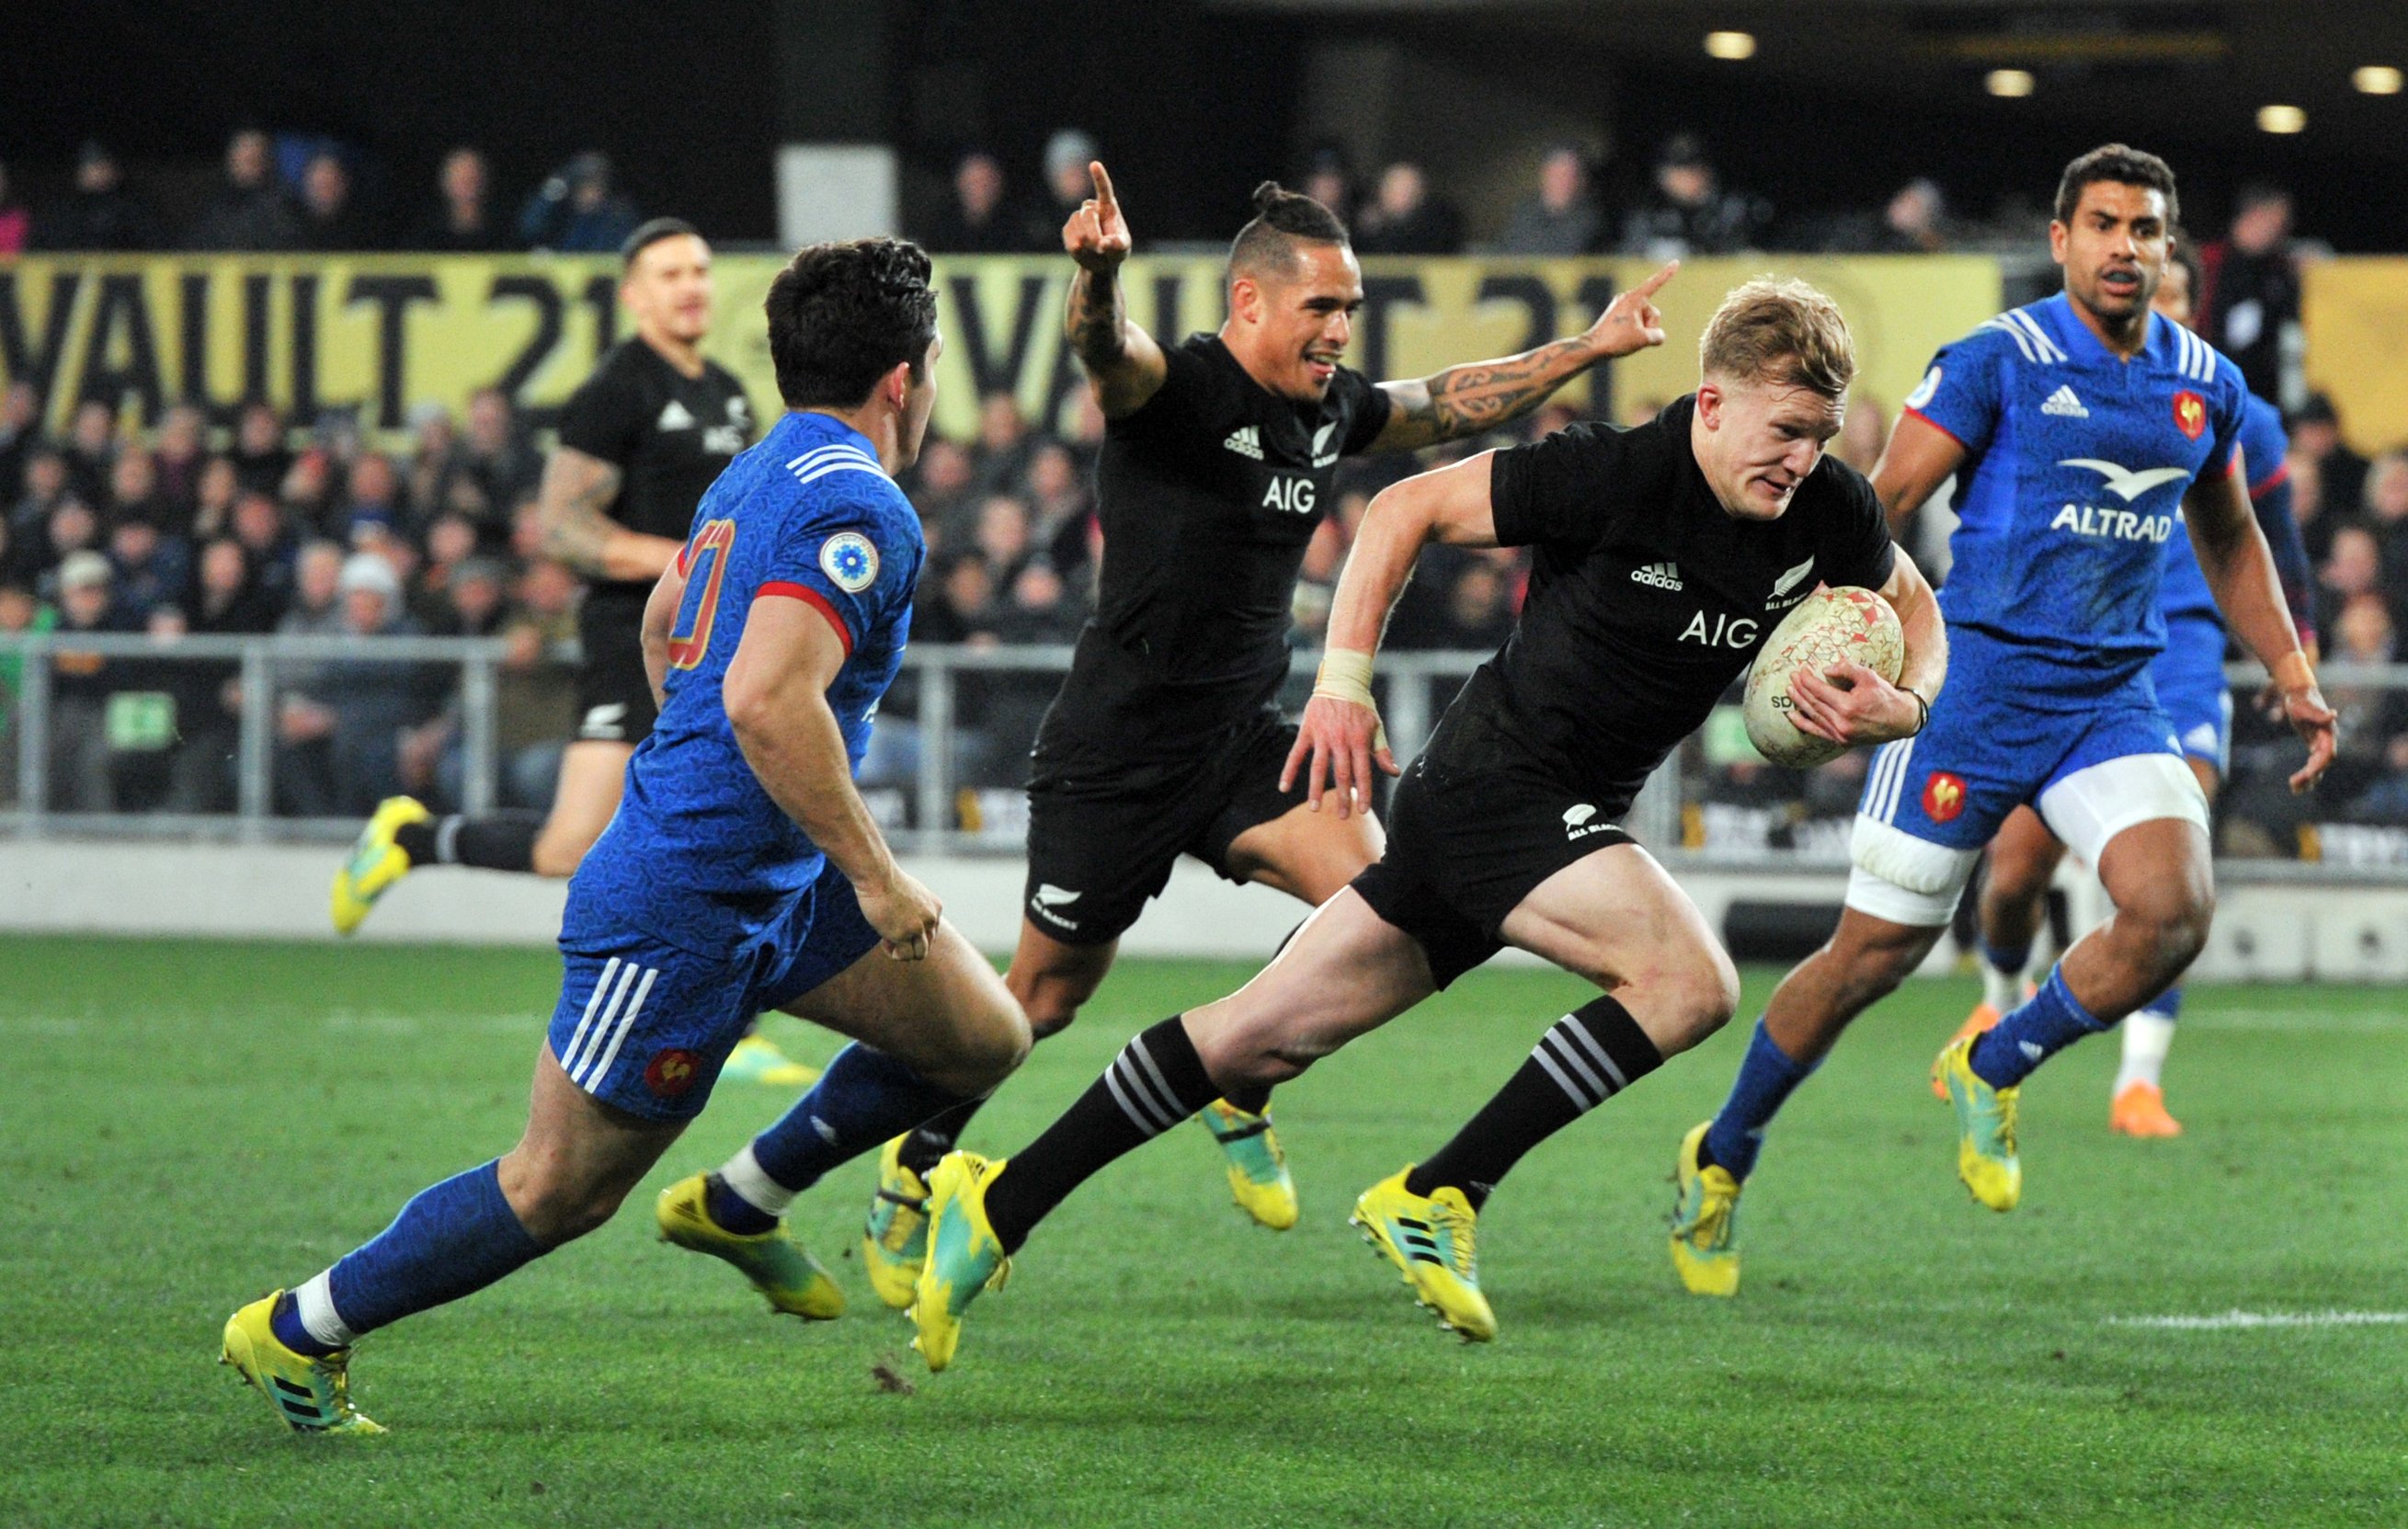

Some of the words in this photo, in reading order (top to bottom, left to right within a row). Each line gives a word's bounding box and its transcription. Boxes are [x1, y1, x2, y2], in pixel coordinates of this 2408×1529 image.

[1262, 475, 1316, 514] AIG
[2050, 504, 2173, 543] ALTRAD
[1630, 570, 1683, 591] adidas
[1677, 610, 1759, 649] AIG
